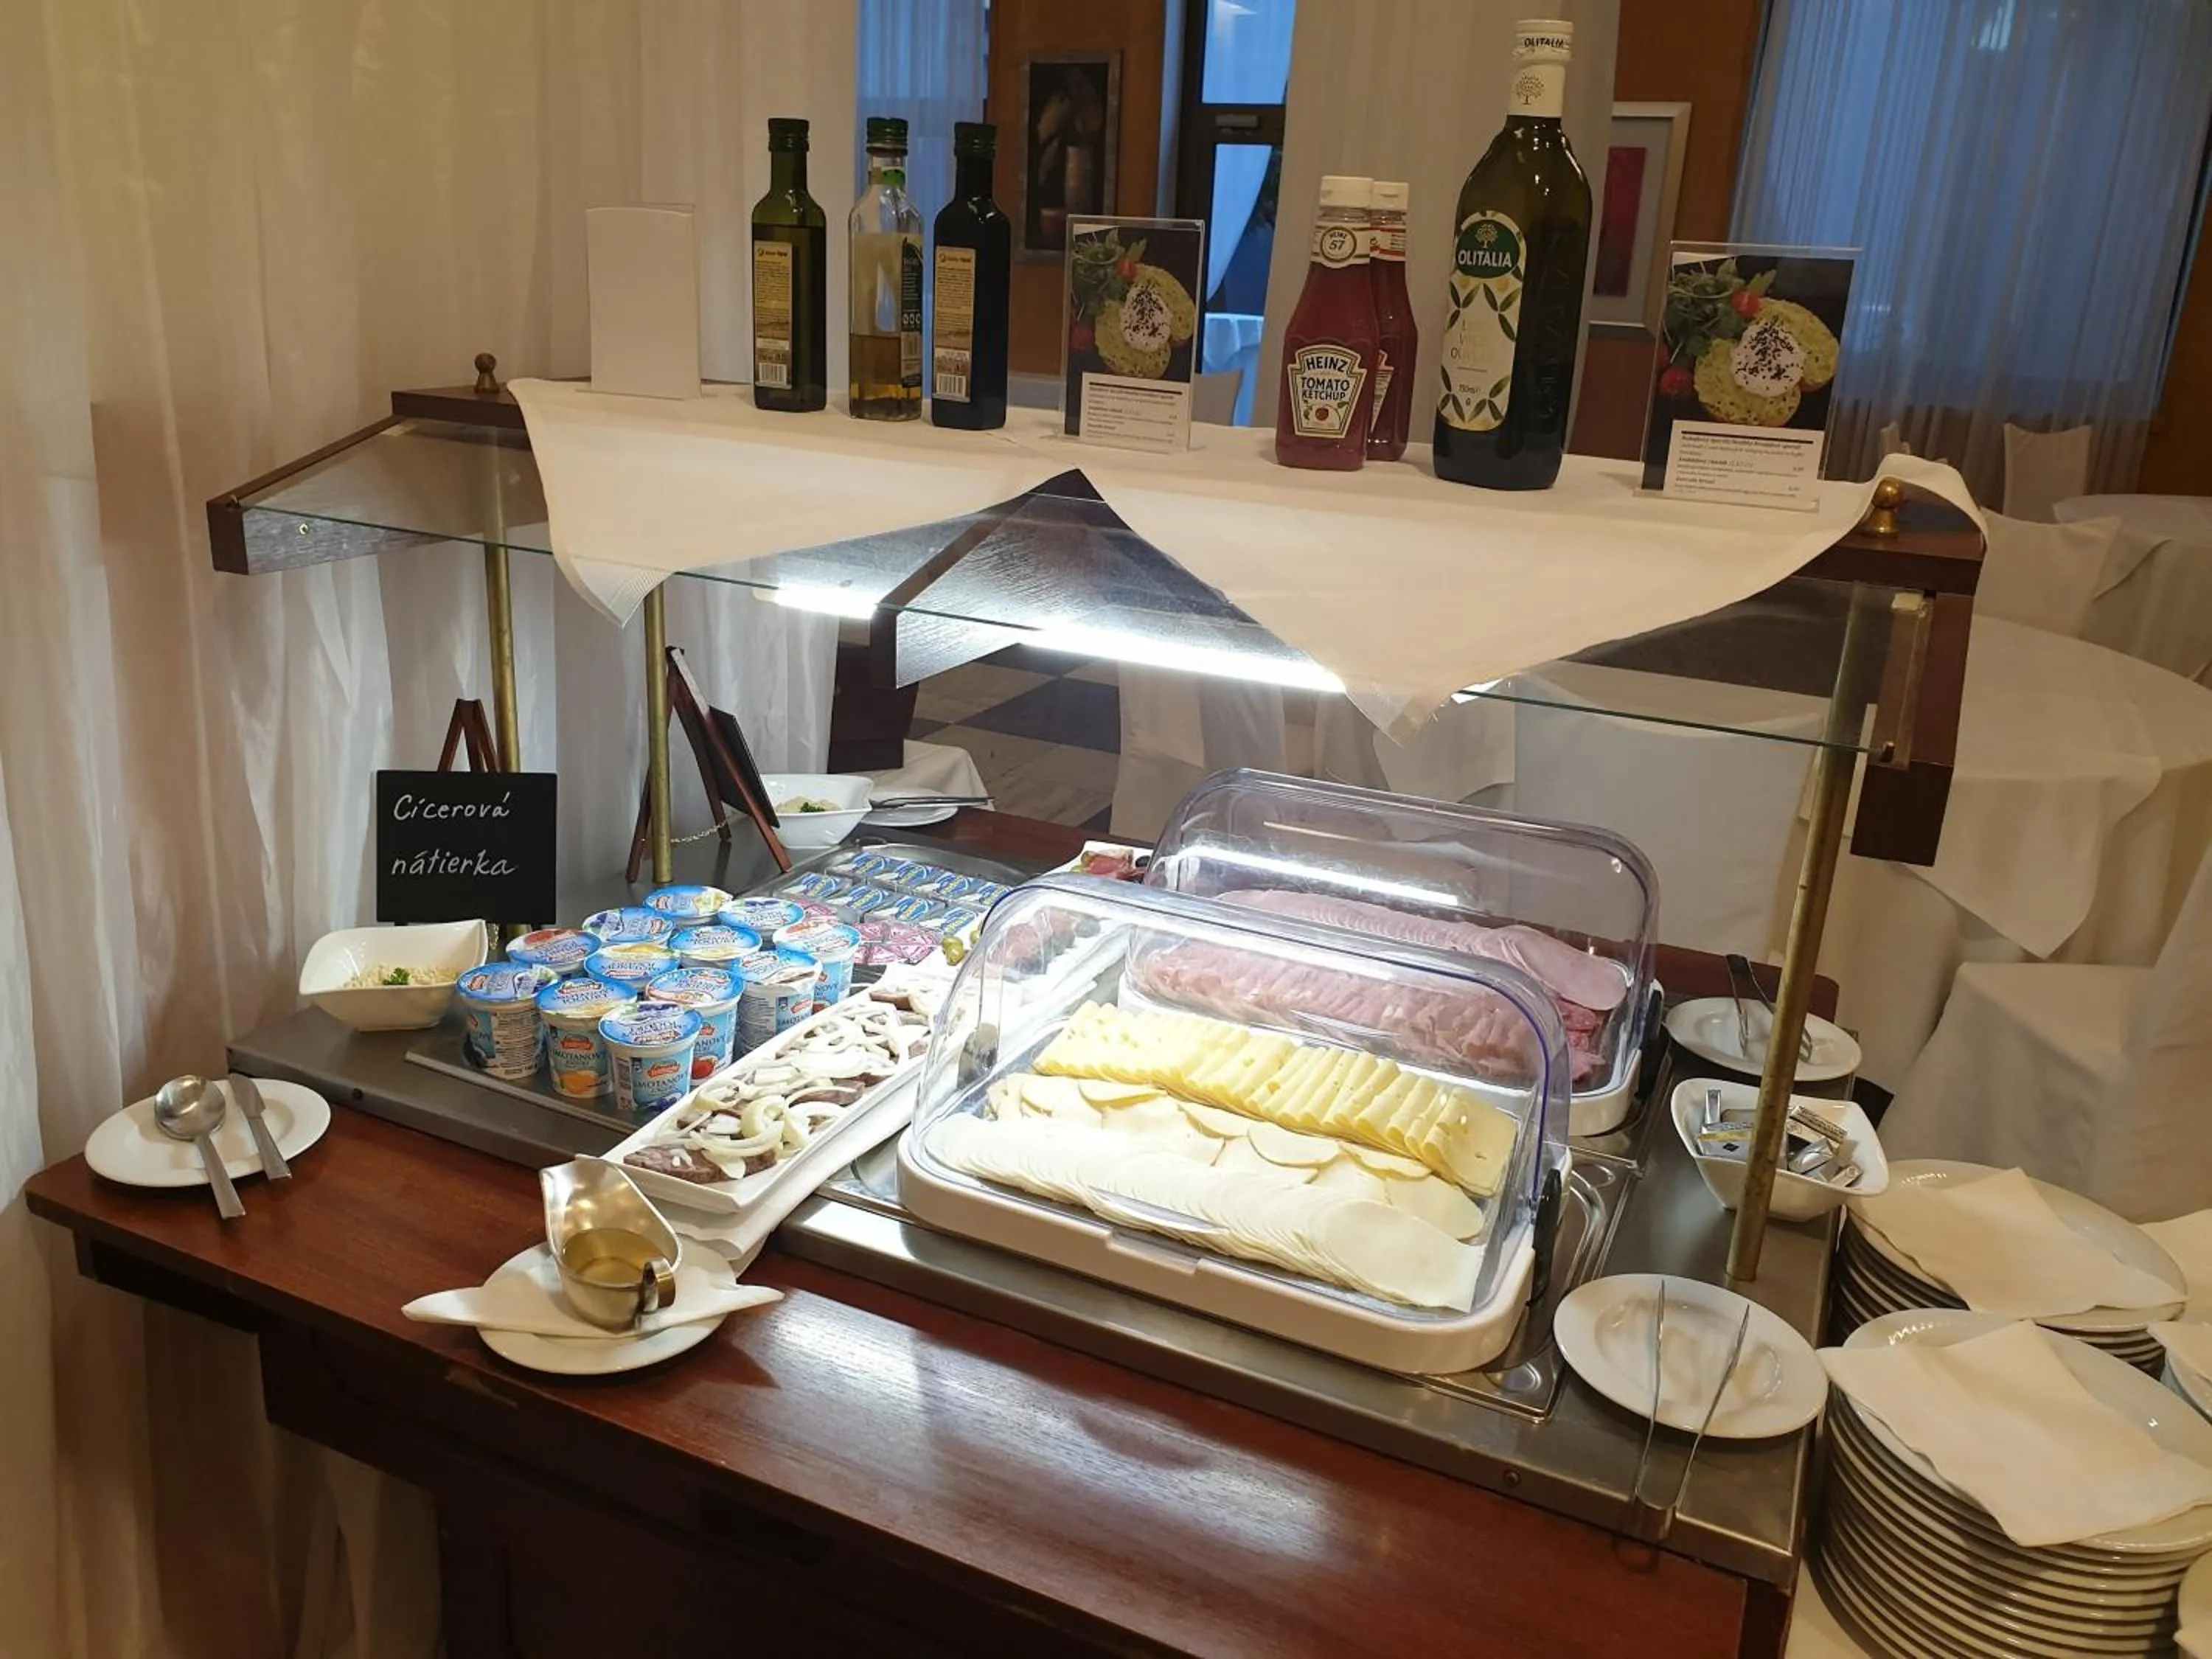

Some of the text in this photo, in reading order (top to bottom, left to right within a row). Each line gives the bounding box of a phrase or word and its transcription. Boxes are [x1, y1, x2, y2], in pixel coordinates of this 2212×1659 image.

[1329, 240, 1346, 251] 57
[1458, 249, 1512, 267] OLITALIA
[1306, 356, 1348, 372] HEINZ
[1301, 377, 1350, 391] TOMATO
[1302, 390, 1346, 400] KETCHUP
[392, 849, 516, 876] nátierka
